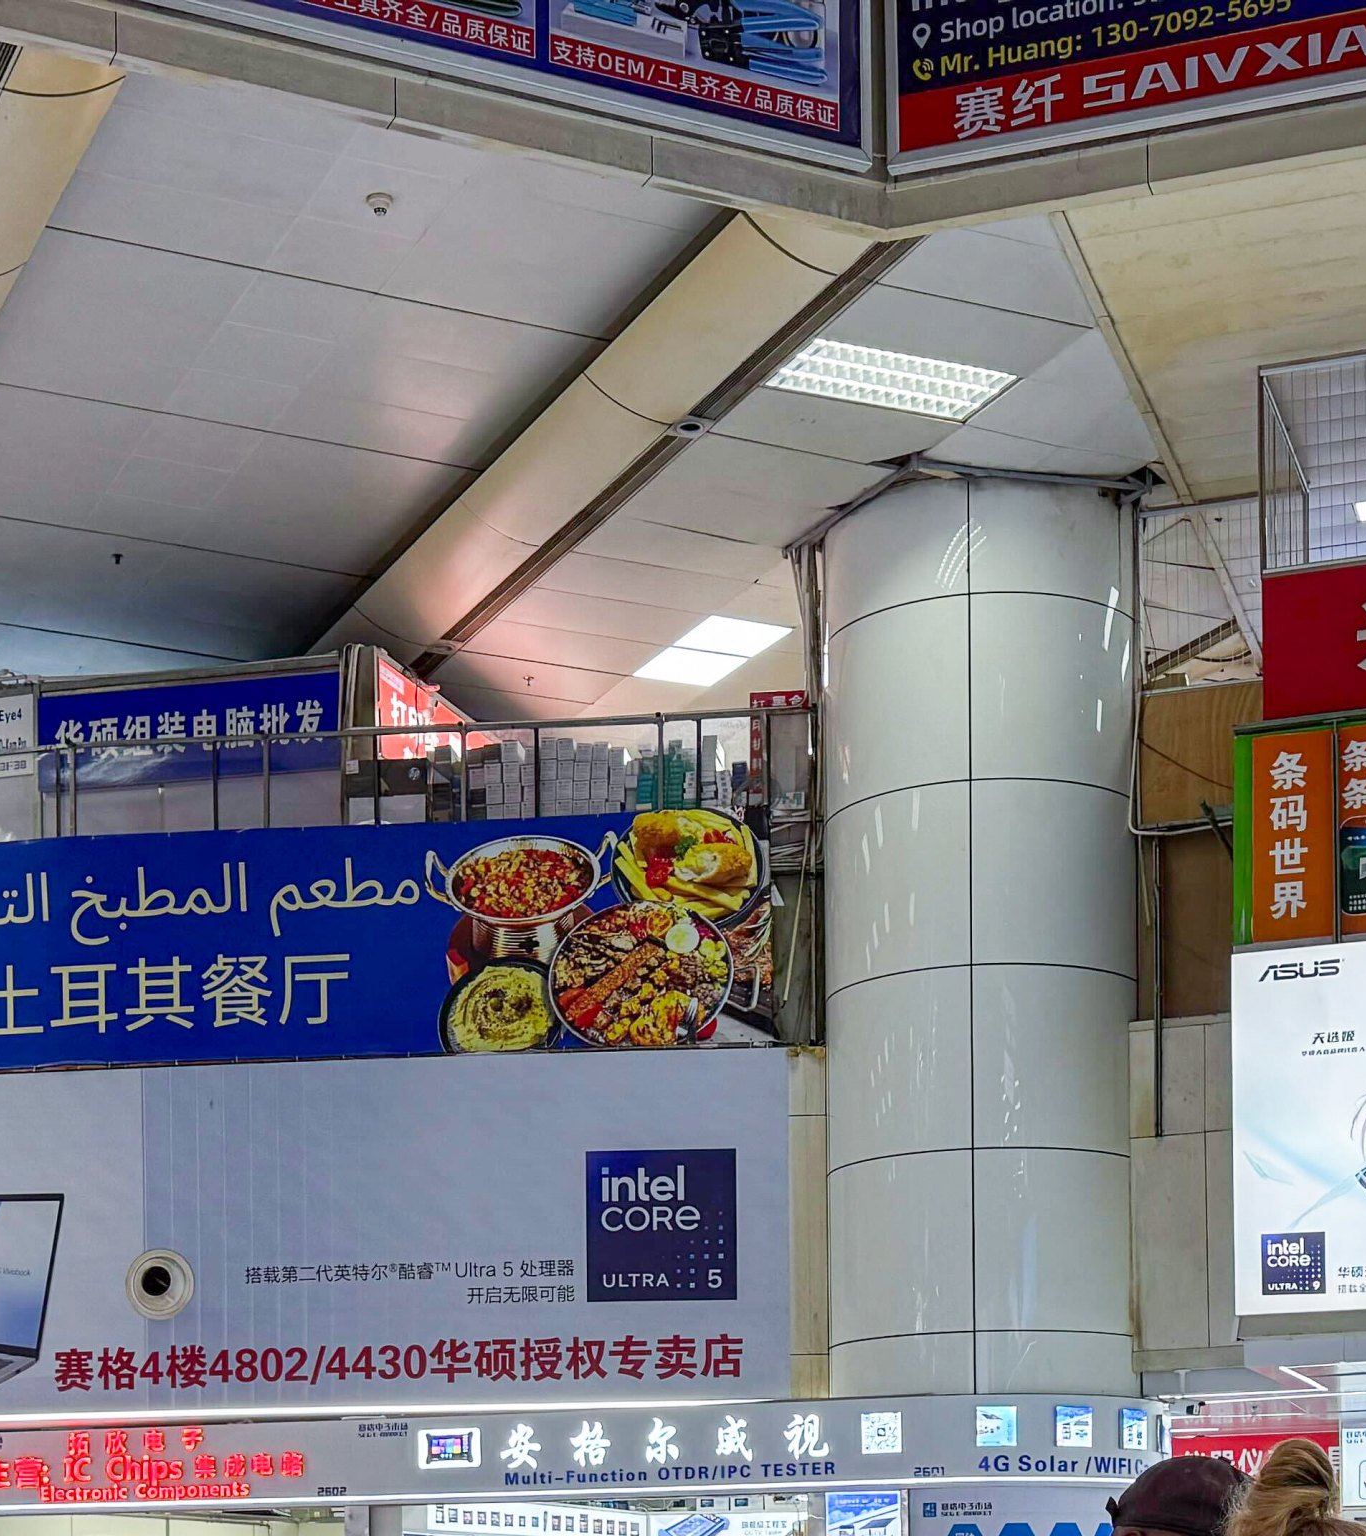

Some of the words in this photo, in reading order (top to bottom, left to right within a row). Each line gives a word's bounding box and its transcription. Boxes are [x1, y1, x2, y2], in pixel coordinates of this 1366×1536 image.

[940, 15, 1005, 42] Shop
[941, 52, 980, 76] Mr.
[988, 33, 1082, 67] Huang:
[552, 38, 837, 128] 支持OEM/工具齐全/品质保证
[953, 73, 1064, 139] 赛纤
[0, 709, 22, 723] Eye4
[54, 699, 324, 759] 华硕组装电脑批发
[1268, 750, 1308, 919] 条码世界
[1258, 959, 1340, 982] ASUS
[1312, 1030, 1355, 1044] 天选姬
[601, 1165, 685, 1202] intel
[1267, 1238, 1305, 1256] intel
[454, 1260, 498, 1279] Ultra
[502, 1261, 513, 1278] 5
[520, 1260, 575, 1278] 处理器
[602, 1272, 669, 1288] ULTRA
[707, 1269, 723, 1288] 5
[467, 1285, 575, 1304] 开启无限可能
[1312, 1281, 1321, 1290] 9
[54, 1334, 744, 1393] 赛格4楼4802/4430华硕授权专卖店
[63, 1455, 92, 1483] IC
[104, 1453, 183, 1484] Chips
[193, 1450, 305, 1479] 集成电路
[504, 1466, 647, 1488] Multi-Function
[657, 1462, 752, 1481] OTDR/IPC
[761, 1461, 836, 1478] TESTER
[978, 1454, 1010, 1473] 4G
[1018, 1455, 1078, 1472] Solar
[39, 1484, 130, 1503] Electronic
[134, 1477, 250, 1501] Components
